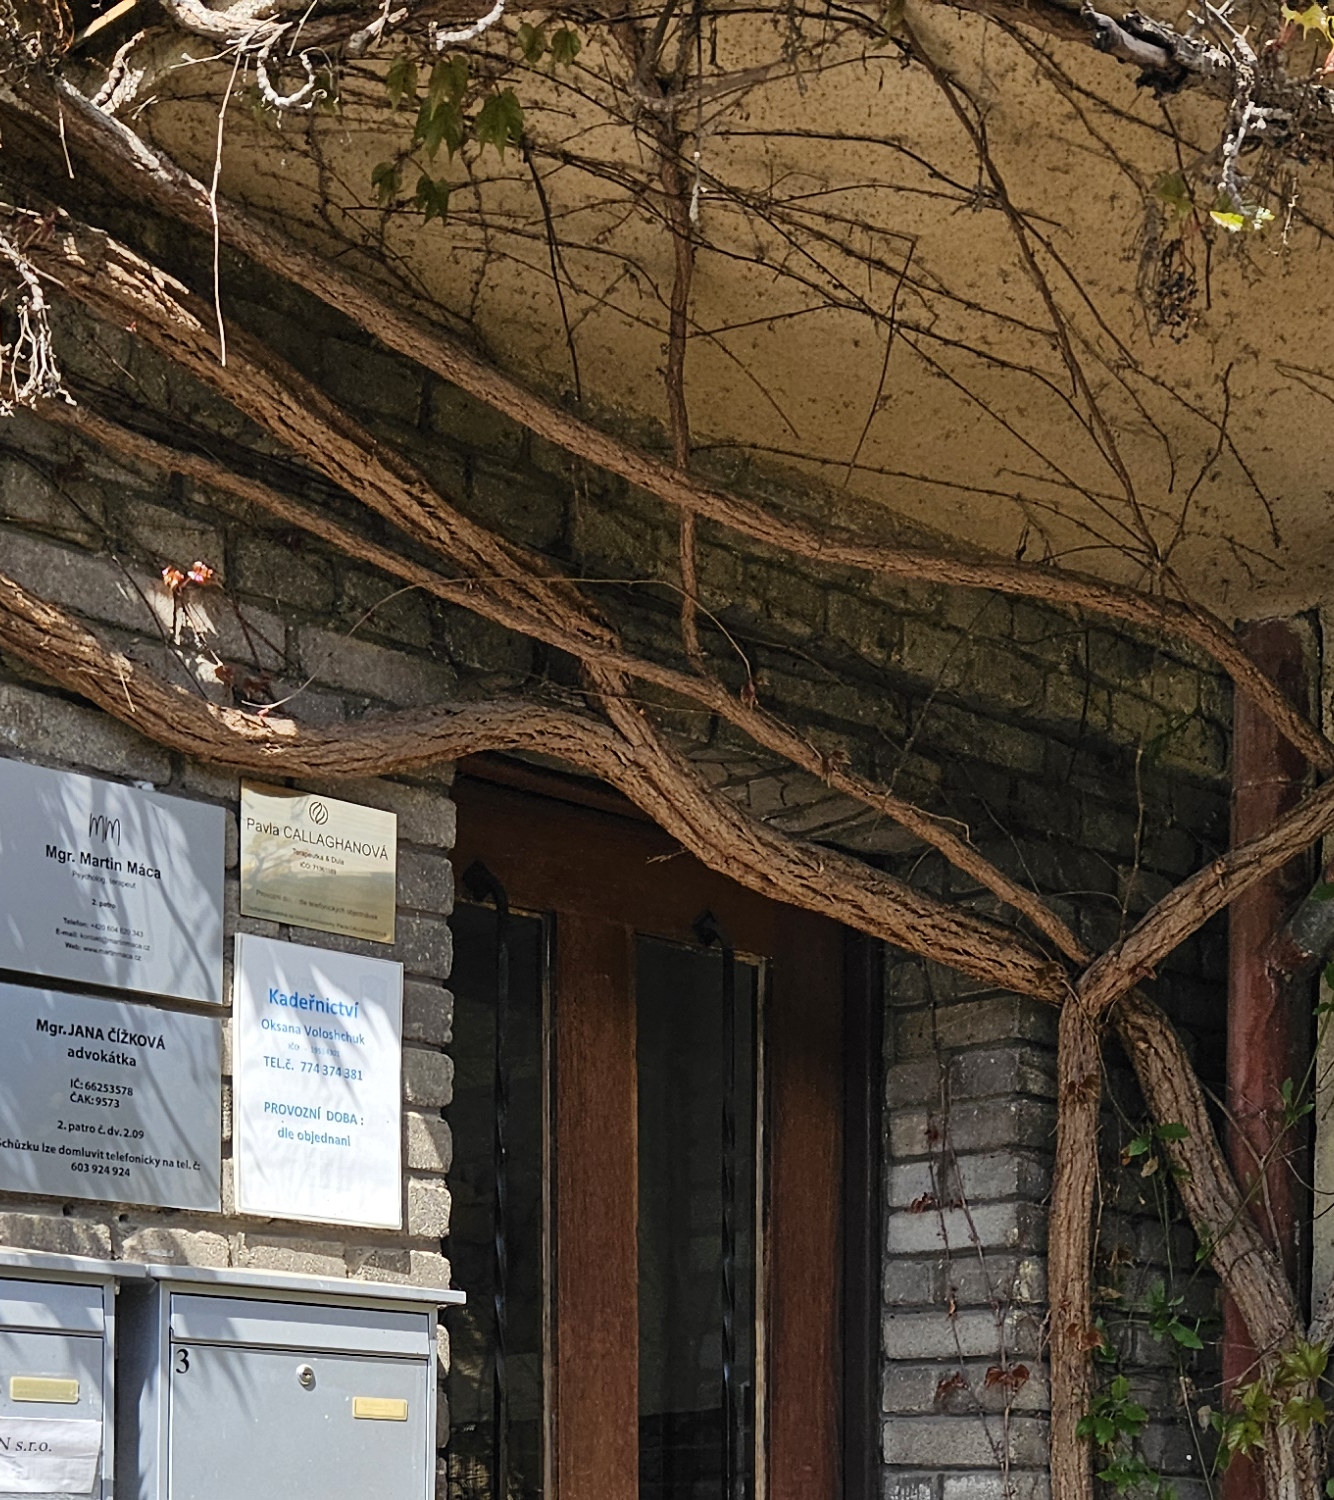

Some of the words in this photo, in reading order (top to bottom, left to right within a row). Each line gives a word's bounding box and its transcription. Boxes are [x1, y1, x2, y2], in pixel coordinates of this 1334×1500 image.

[246, 817, 280, 836] Pavla
[283, 826, 389, 861] CALLAGHANOVÁ
[45, 844, 76, 864] Mgr.
[80, 852, 122, 872] Martin
[127, 862, 161, 880] Máca
[269, 988, 359, 1018] Kadeřnictví
[35, 1018, 67, 1036] Mgr.
[67, 1023, 104, 1042] JANA
[107, 1027, 166, 1050] ČÍŽKOVÁ
[261, 1018, 301, 1035] Oksana
[303, 1025, 365, 1045] Voloshchuk
[67, 1046, 137, 1067] advokátka
[300, 1061, 320, 1074] 774
[322, 1064, 342, 1077] 374
[343, 1068, 363, 1081] 381
[70, 1078, 84, 1090] IČ:
[84, 1081, 134, 1097] 66253578
[69, 1091, 95, 1105] ČAK:
[95, 1096, 120, 1108] 9573
[264, 1101, 321, 1120] PROVOZNÍ
[326, 1110, 358, 1125] DOBA
[57, 1120, 67, 1131] 2.
[68, 1123, 96, 1134] patro
[123, 1128, 145, 1139] 2.09
[277, 1127, 294, 1140] dle
[42, 1142, 56, 1154] lze
[58, 1144, 105, 1160] domluvit
[106, 1150, 161, 1168] telefonicky
[162, 1159, 174, 1168] na
[176, 1159, 192, 1170] tel.
[71, 1162, 90, 1174] 603
[91, 1164, 110, 1176] 924
[111, 1166, 131, 1178] 924
[175, 1348, 191, 1374] 3
[15, 1439, 53, 1453] s.r.o.
